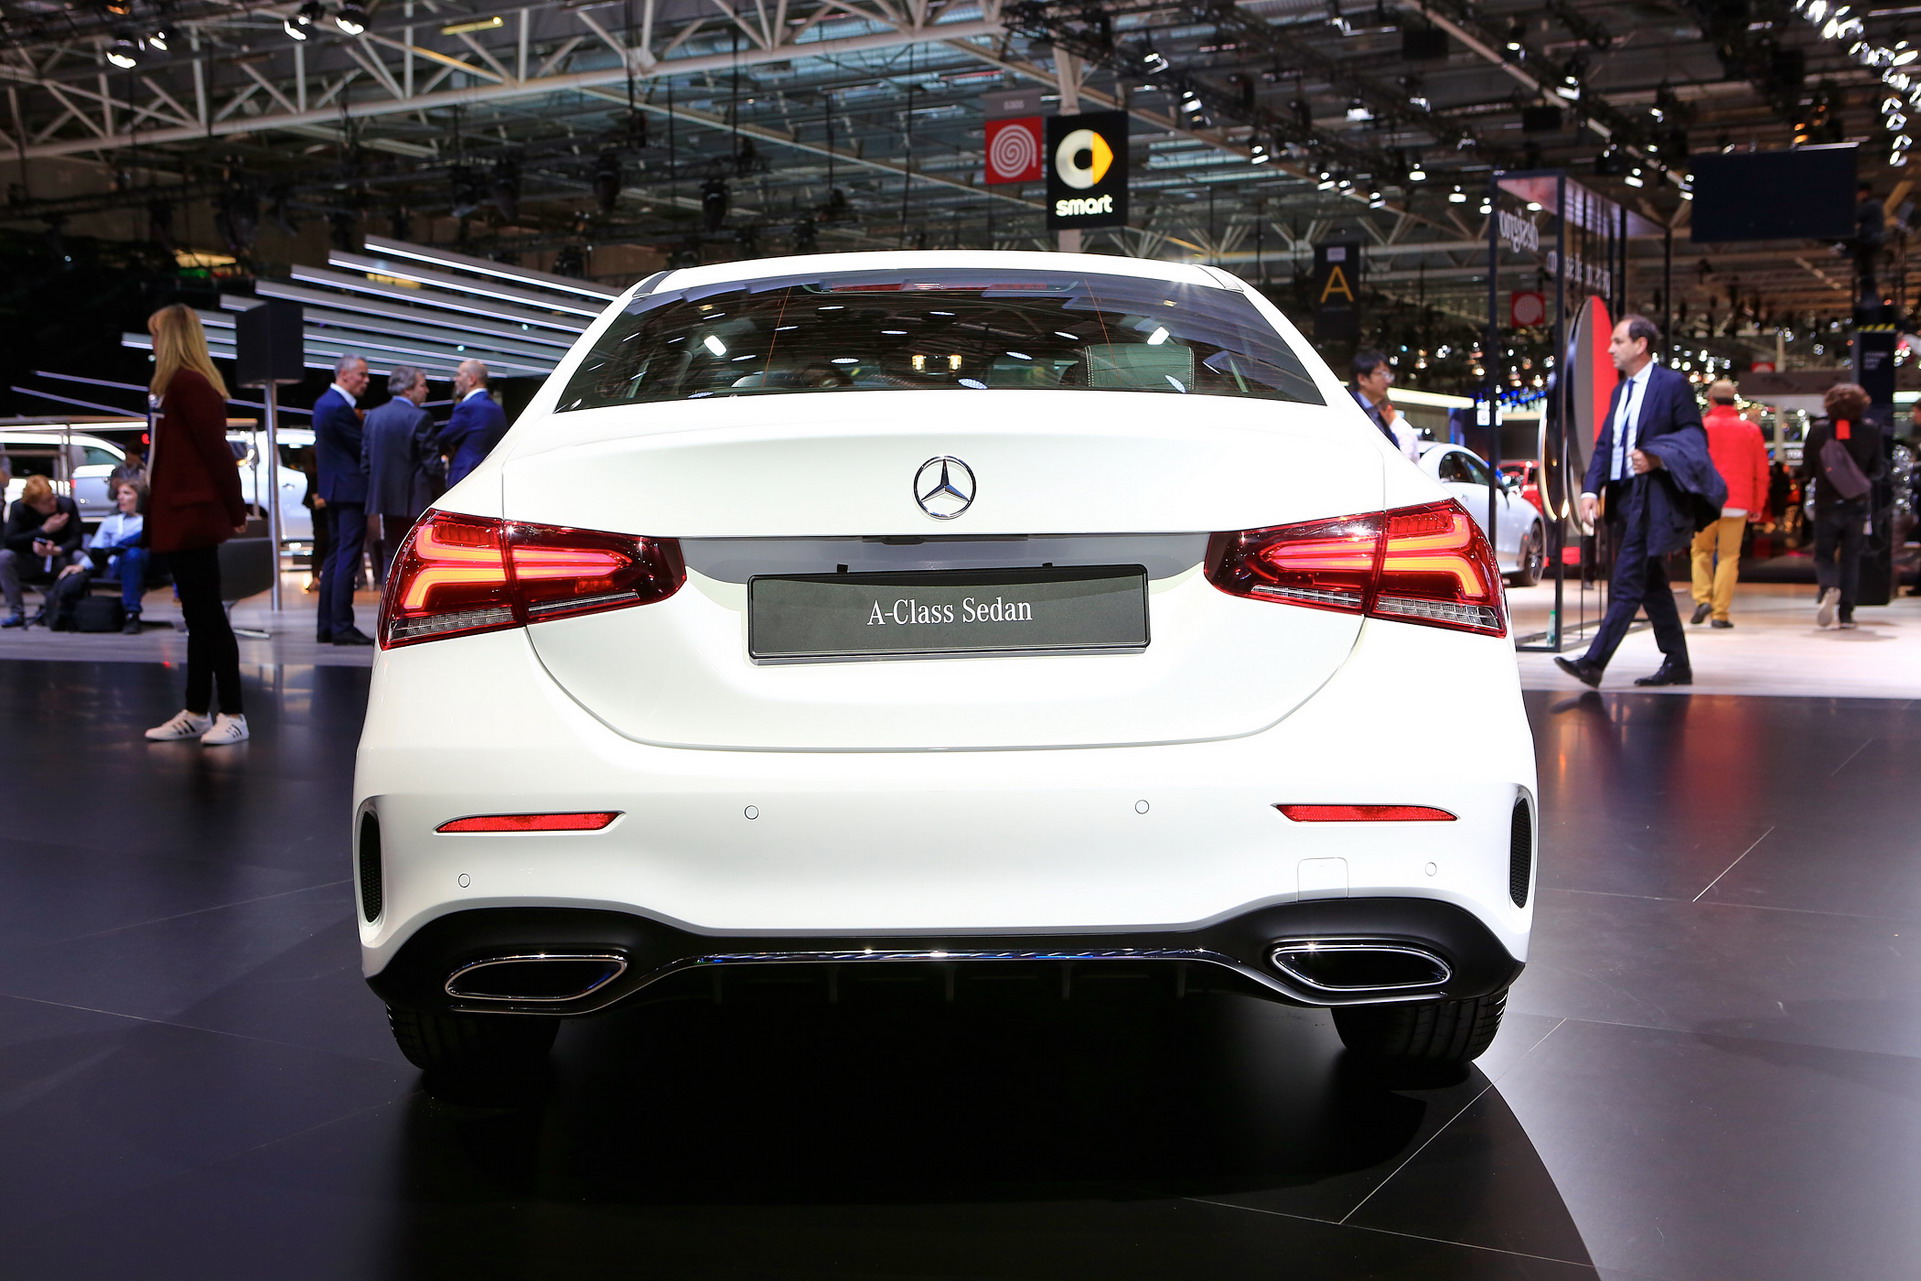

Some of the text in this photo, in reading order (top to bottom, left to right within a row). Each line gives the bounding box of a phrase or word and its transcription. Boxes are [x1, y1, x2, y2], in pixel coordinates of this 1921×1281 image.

[1056, 194, 1113, 217] smart
[1320, 265, 1354, 304] A
[867, 596, 1034, 626] A-Class Sedan
